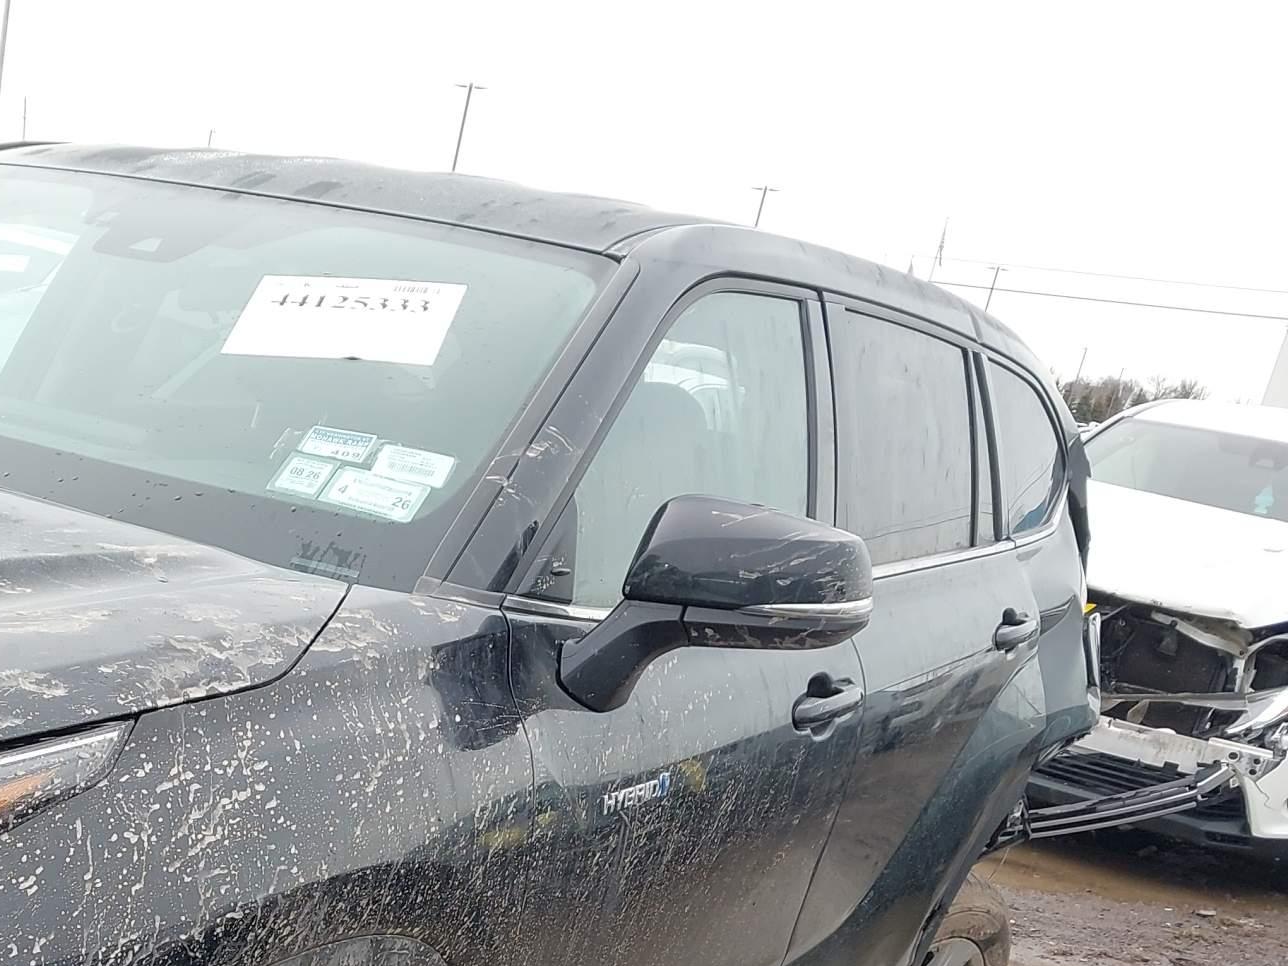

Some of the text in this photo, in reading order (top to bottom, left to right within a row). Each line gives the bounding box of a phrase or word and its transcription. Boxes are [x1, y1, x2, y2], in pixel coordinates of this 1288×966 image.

[271, 293, 431, 312] 44125333
[289, 466, 322, 480] 08 26
[392, 496, 412, 510] 26
[600, 779, 660, 816] HYBRID
